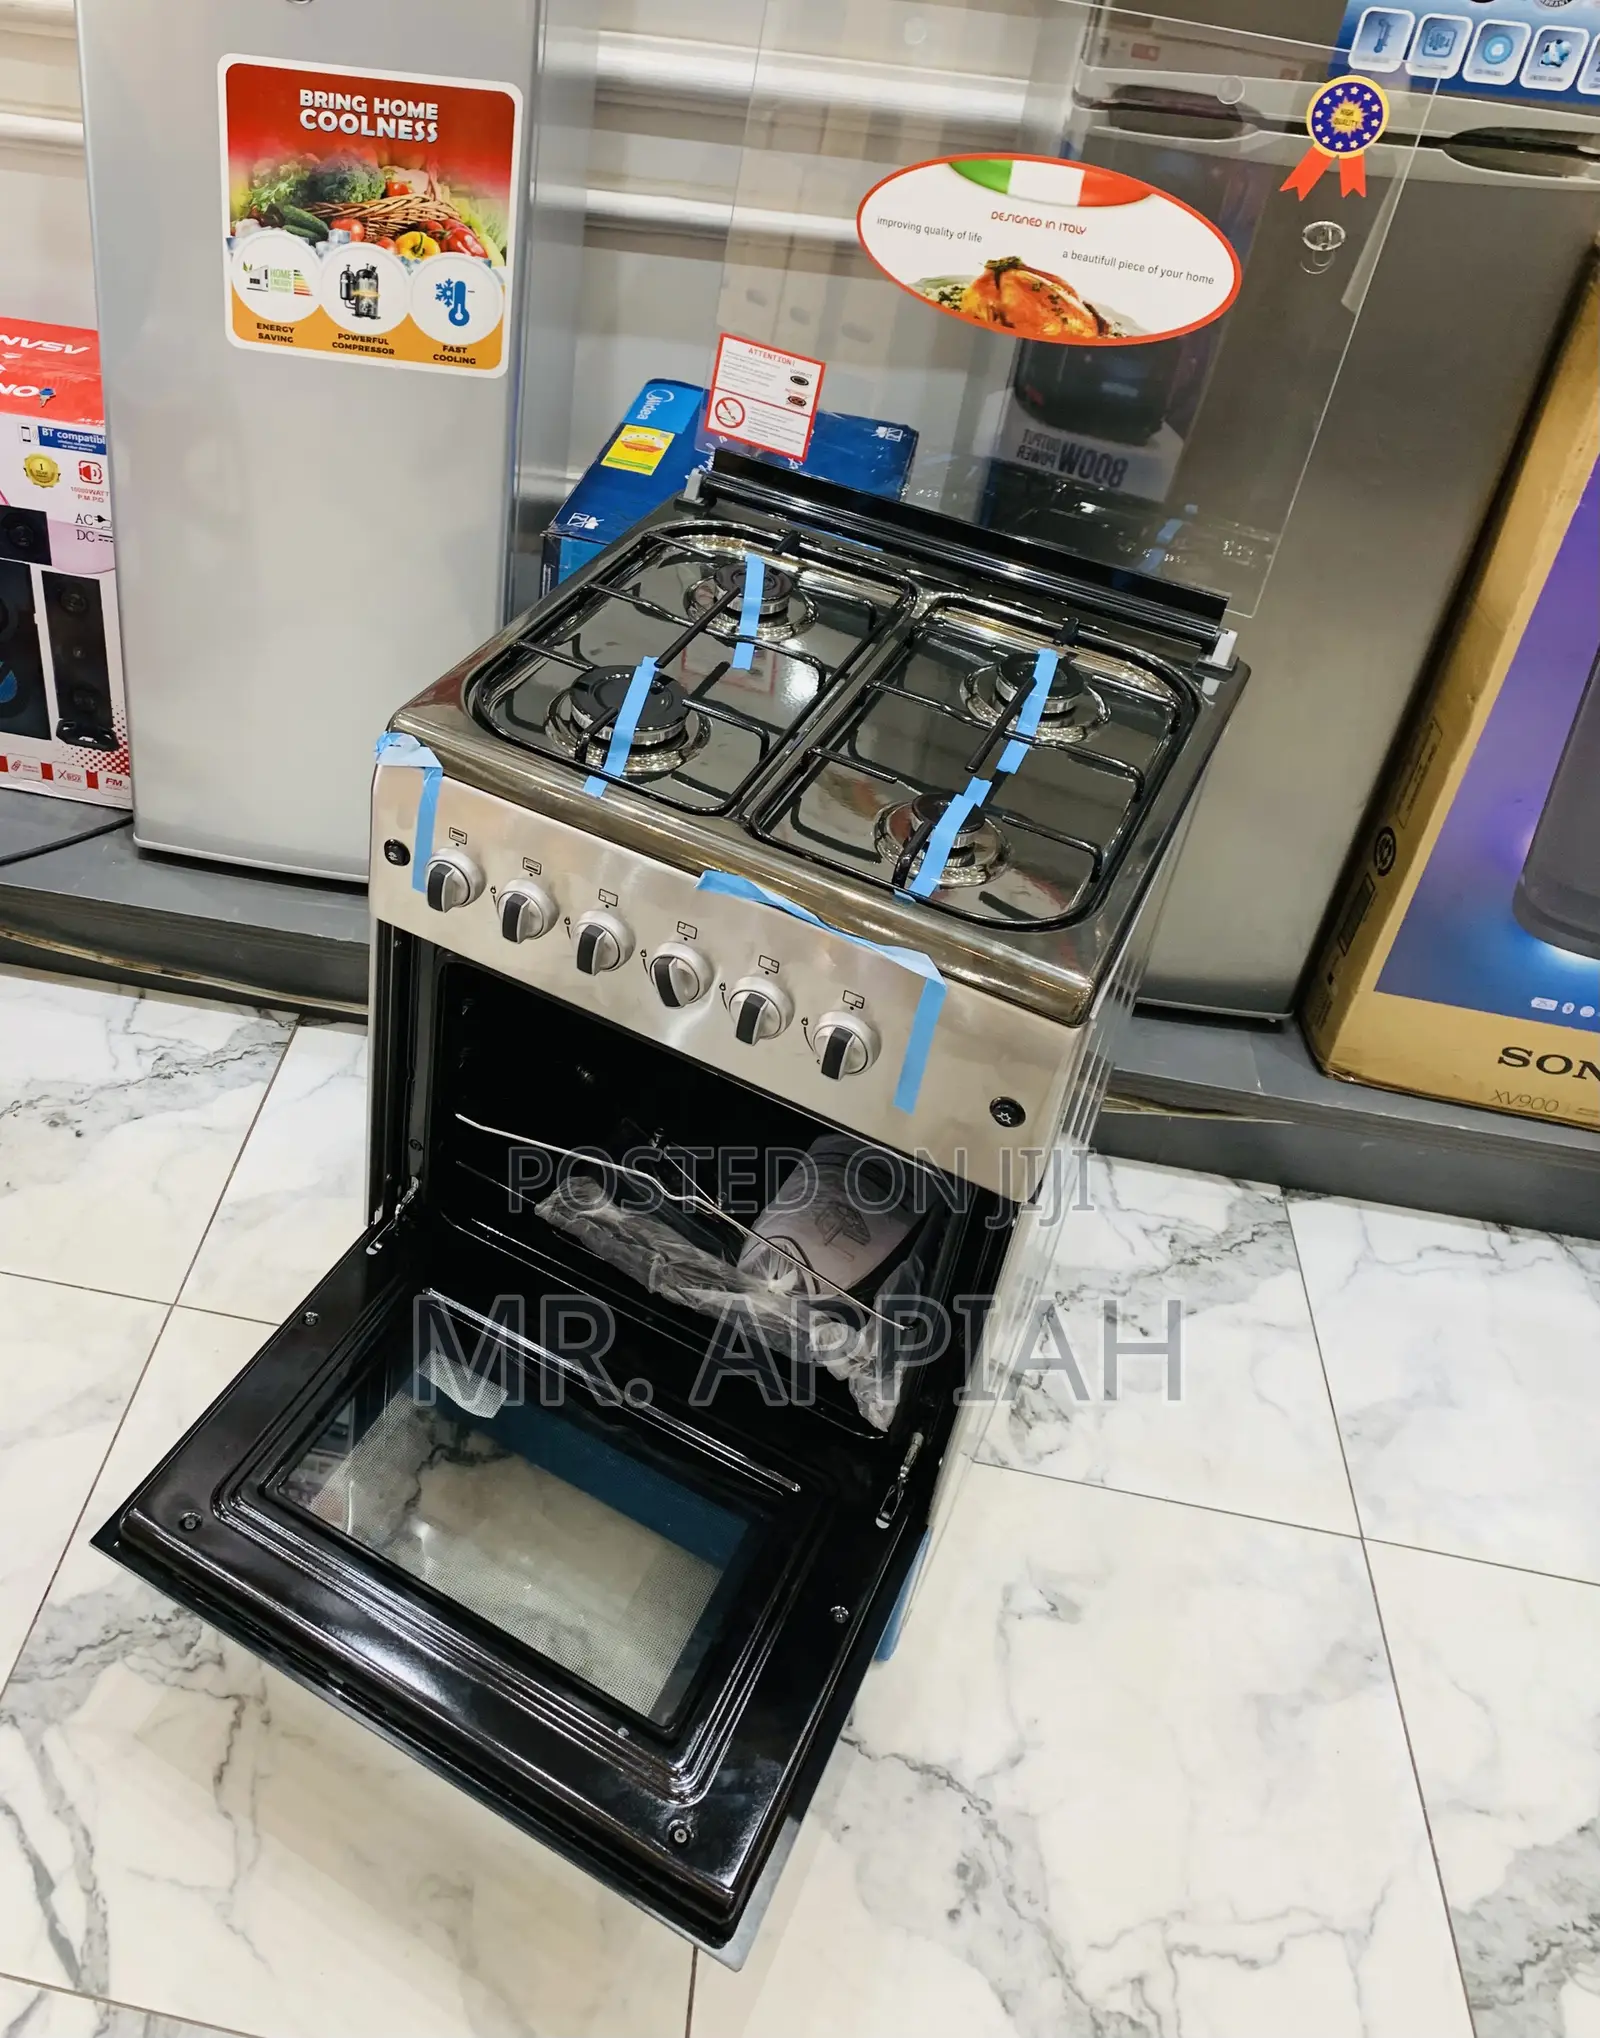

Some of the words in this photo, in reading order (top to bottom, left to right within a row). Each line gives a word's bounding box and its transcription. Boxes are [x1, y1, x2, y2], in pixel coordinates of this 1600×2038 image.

[299, 89, 367, 113] BRING
[373, 97, 439, 121] HOME
[299, 108, 439, 143] COOLNESS
[990, 211, 1042, 228] DESIGNED
[876, 216, 922, 235] improving
[924, 226, 955, 241] quality
[957, 230, 966, 241] of
[968, 231, 983, 244] life
[1070, 250, 1116, 267] beautifull
[1118, 260, 1146, 275] piece
[1147, 264, 1158, 275] of
[1160, 268, 1183, 282] your
[1186, 272, 1215, 285] home
[256, 322, 295, 334] ENERGY
[258, 332, 294, 343] SAVING
[337, 332, 389, 346] POWERFUL
[331, 341, 395, 355] COMPRESSOR
[442, 344, 467, 354] FAST
[432, 353, 476, 365] COOLING
[42, 427, 55, 437] BT
[75, 513, 93, 526] AC
[76, 529, 95, 543] DC
[105, 777, 122, 787] FM
[1488, 1089, 1559, 1113] XV900
